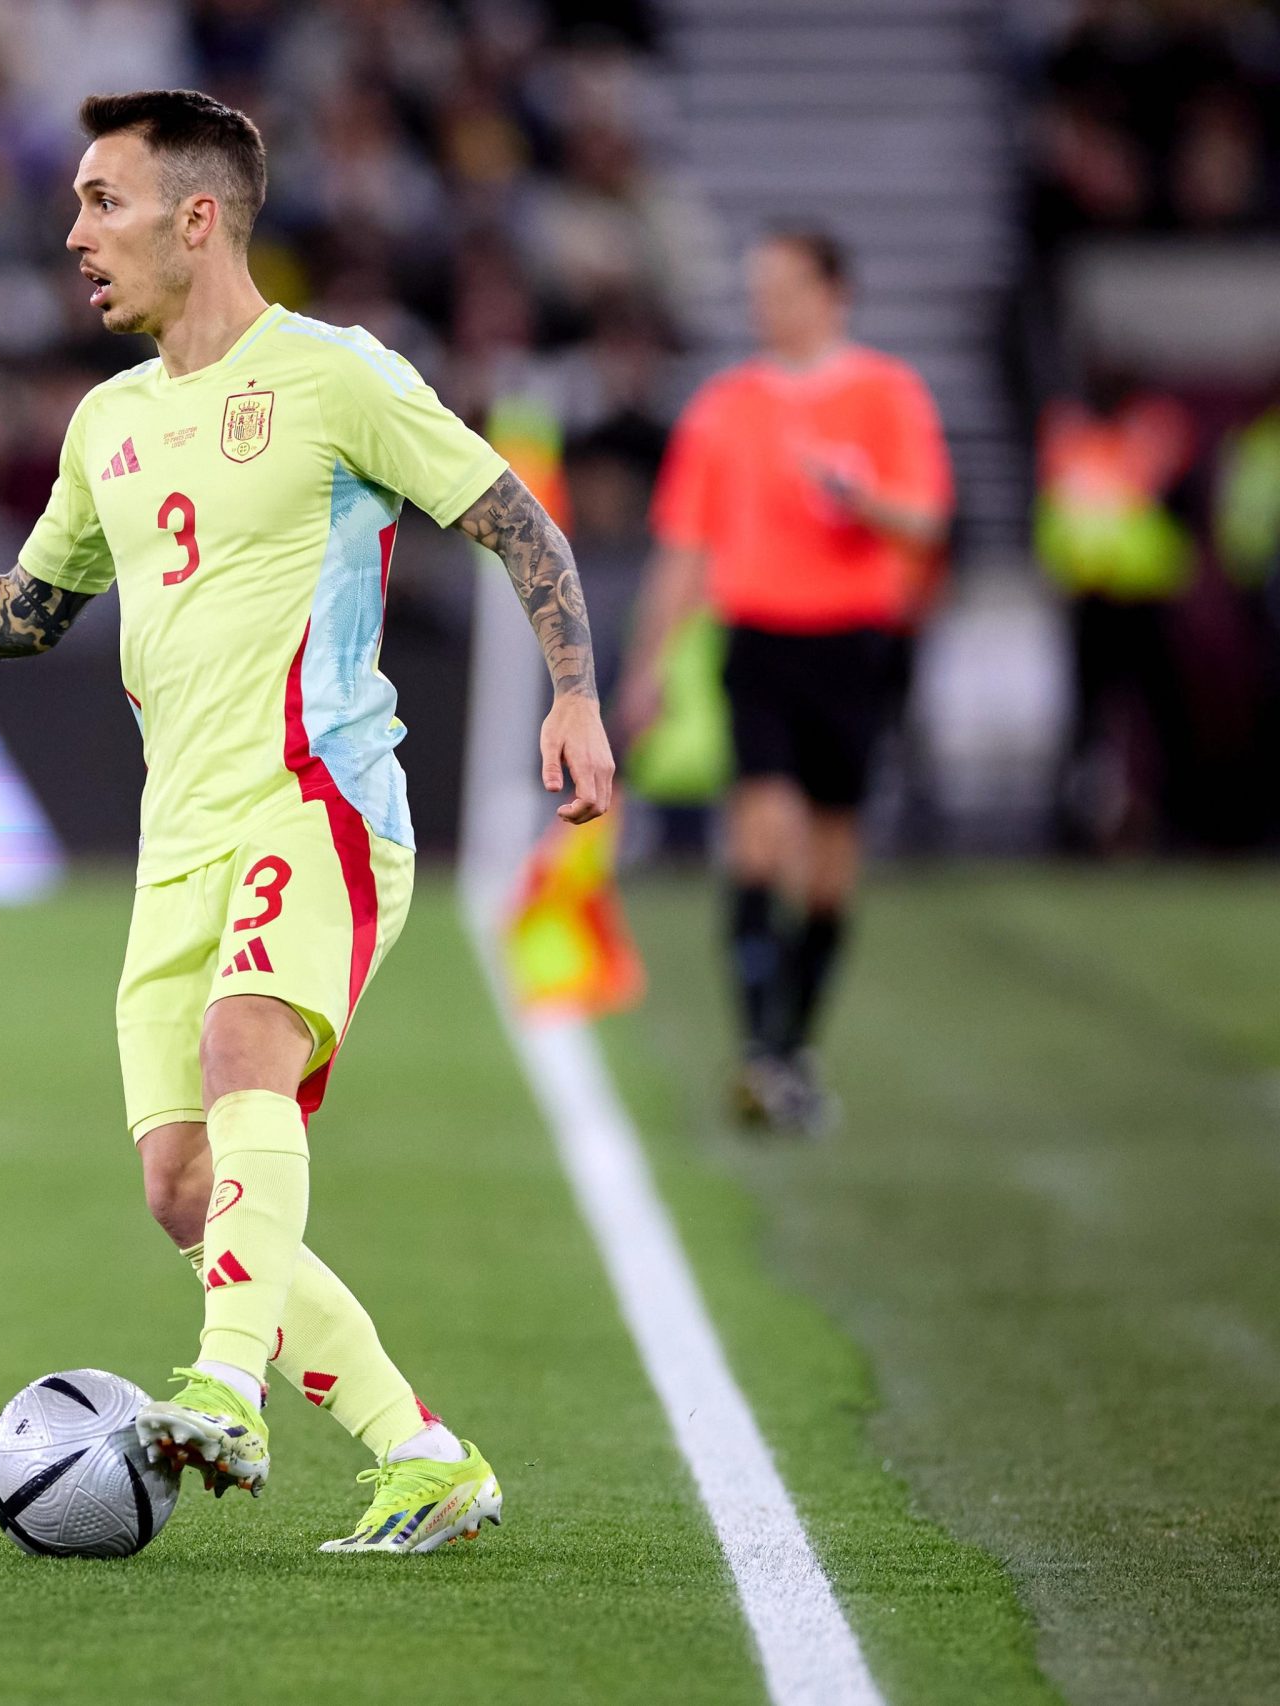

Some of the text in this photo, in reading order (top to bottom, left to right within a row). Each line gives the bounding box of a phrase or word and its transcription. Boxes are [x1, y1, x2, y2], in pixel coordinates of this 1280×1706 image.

[157, 491, 200, 587] 3
[233, 854, 293, 934] 3
[425, 1495, 458, 1534] CRAZYFAST
